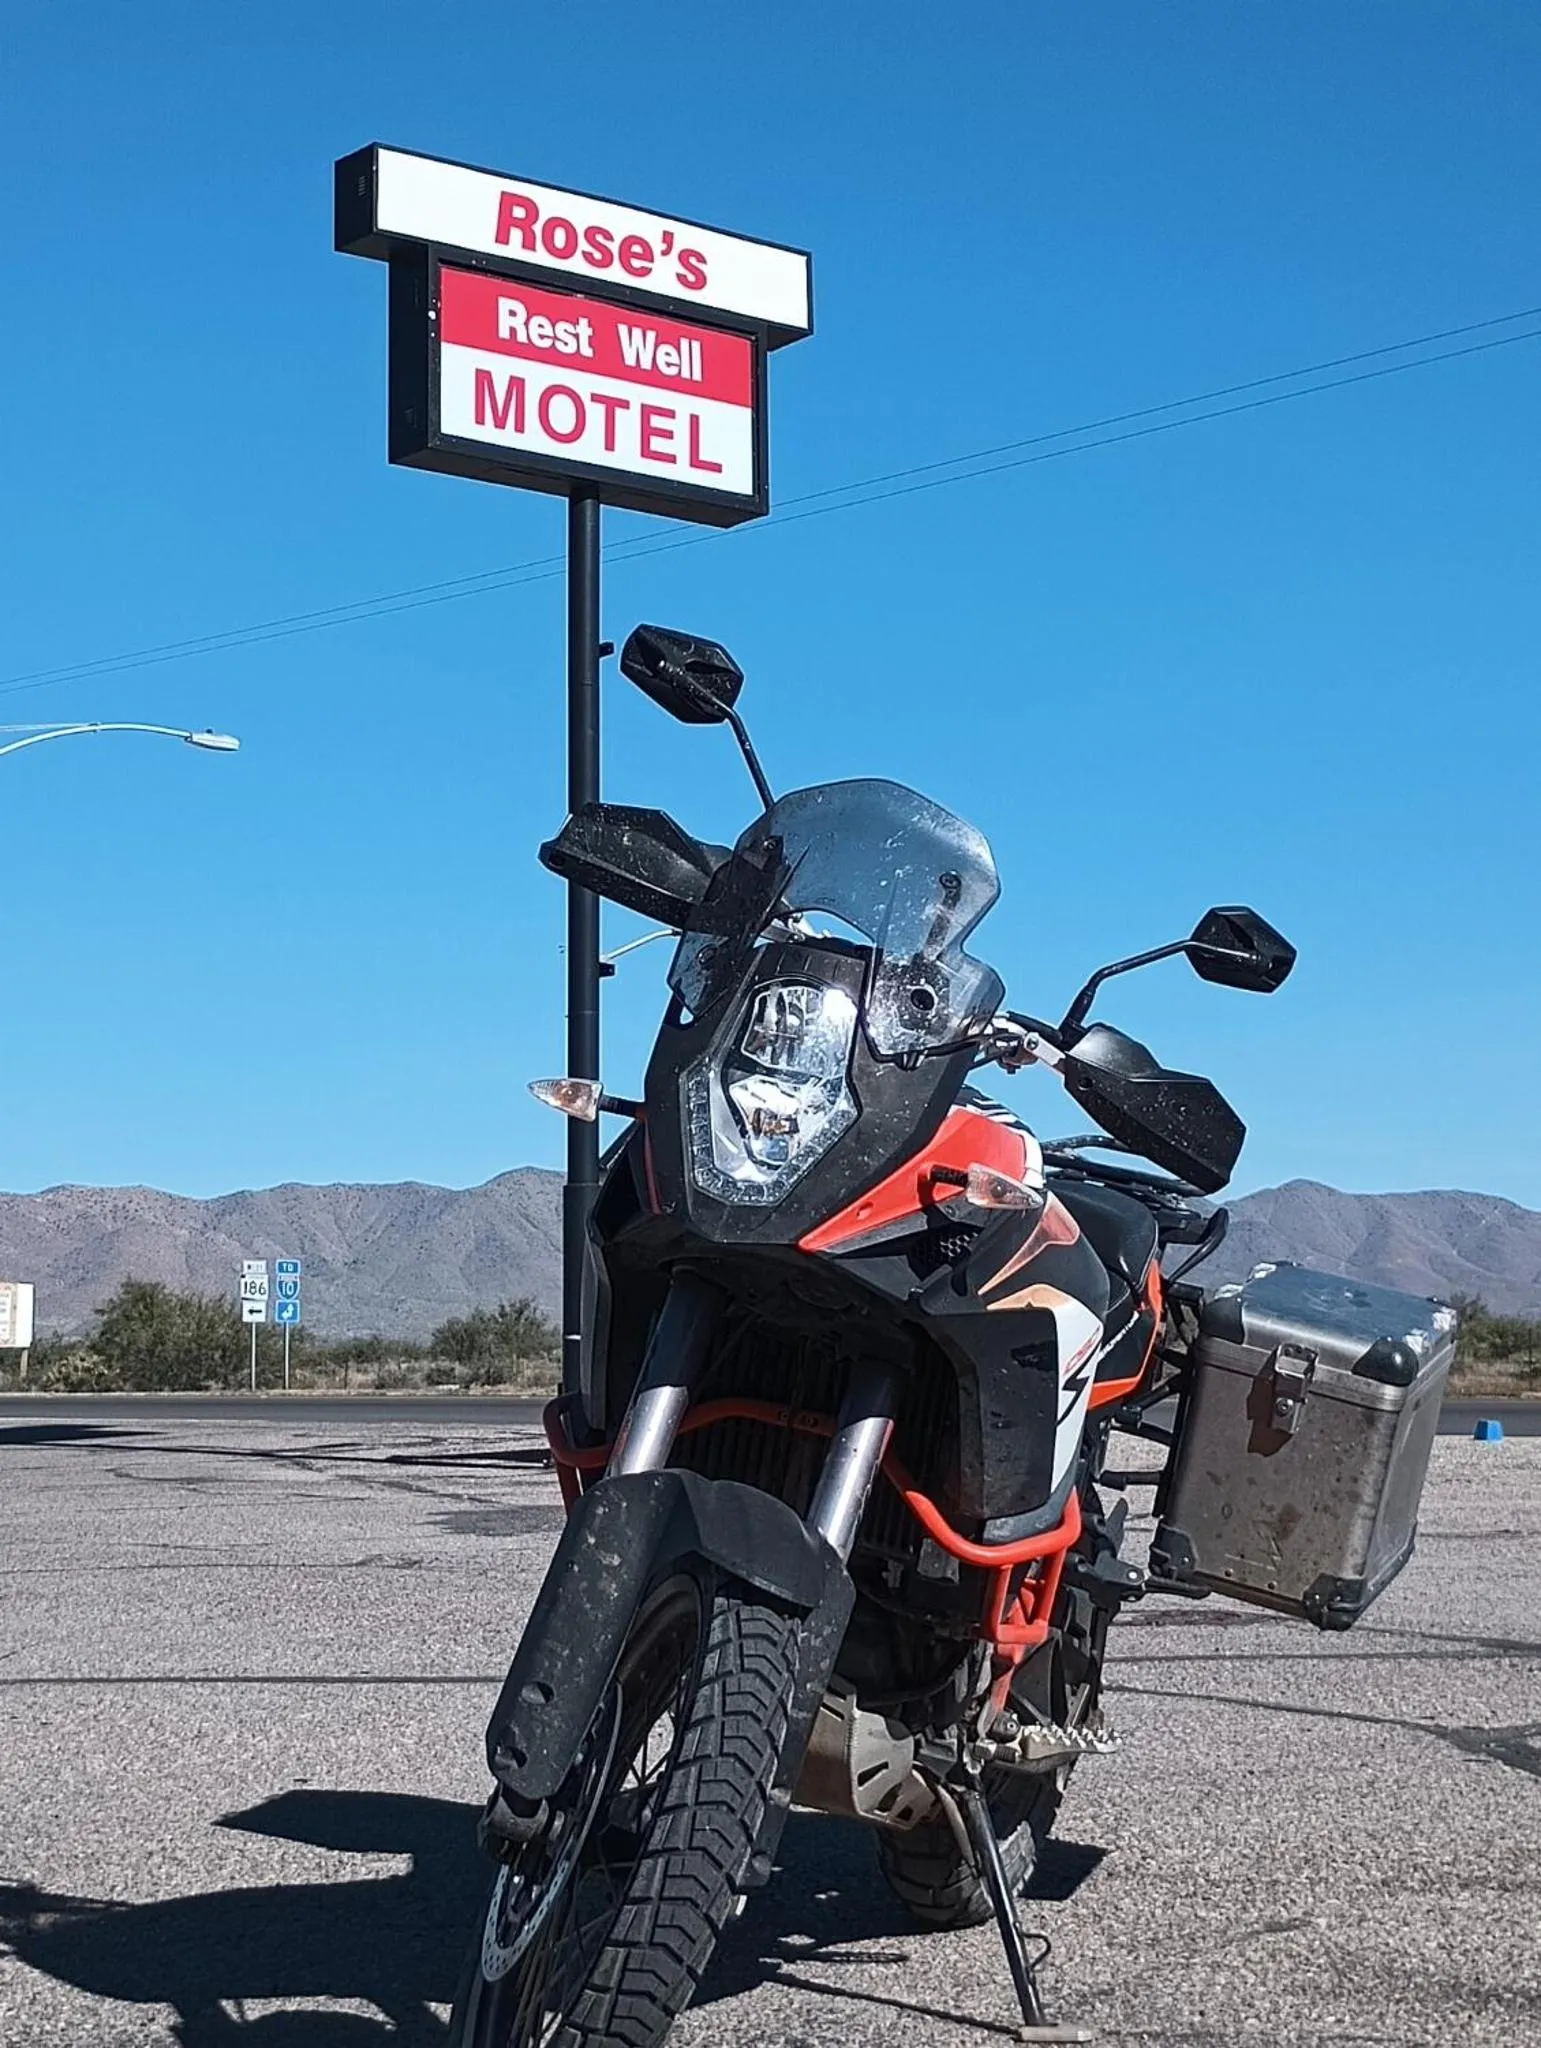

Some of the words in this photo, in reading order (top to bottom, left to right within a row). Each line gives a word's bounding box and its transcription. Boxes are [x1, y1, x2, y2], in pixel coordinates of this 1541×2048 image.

[494, 191, 708, 291] Rose's
[497, 296, 594, 358] Rest
[617, 323, 703, 382] Well
[473, 367, 723, 474] MOTEL
[243, 1280, 266, 1295] 186
[282, 1281, 294, 1295] 10
